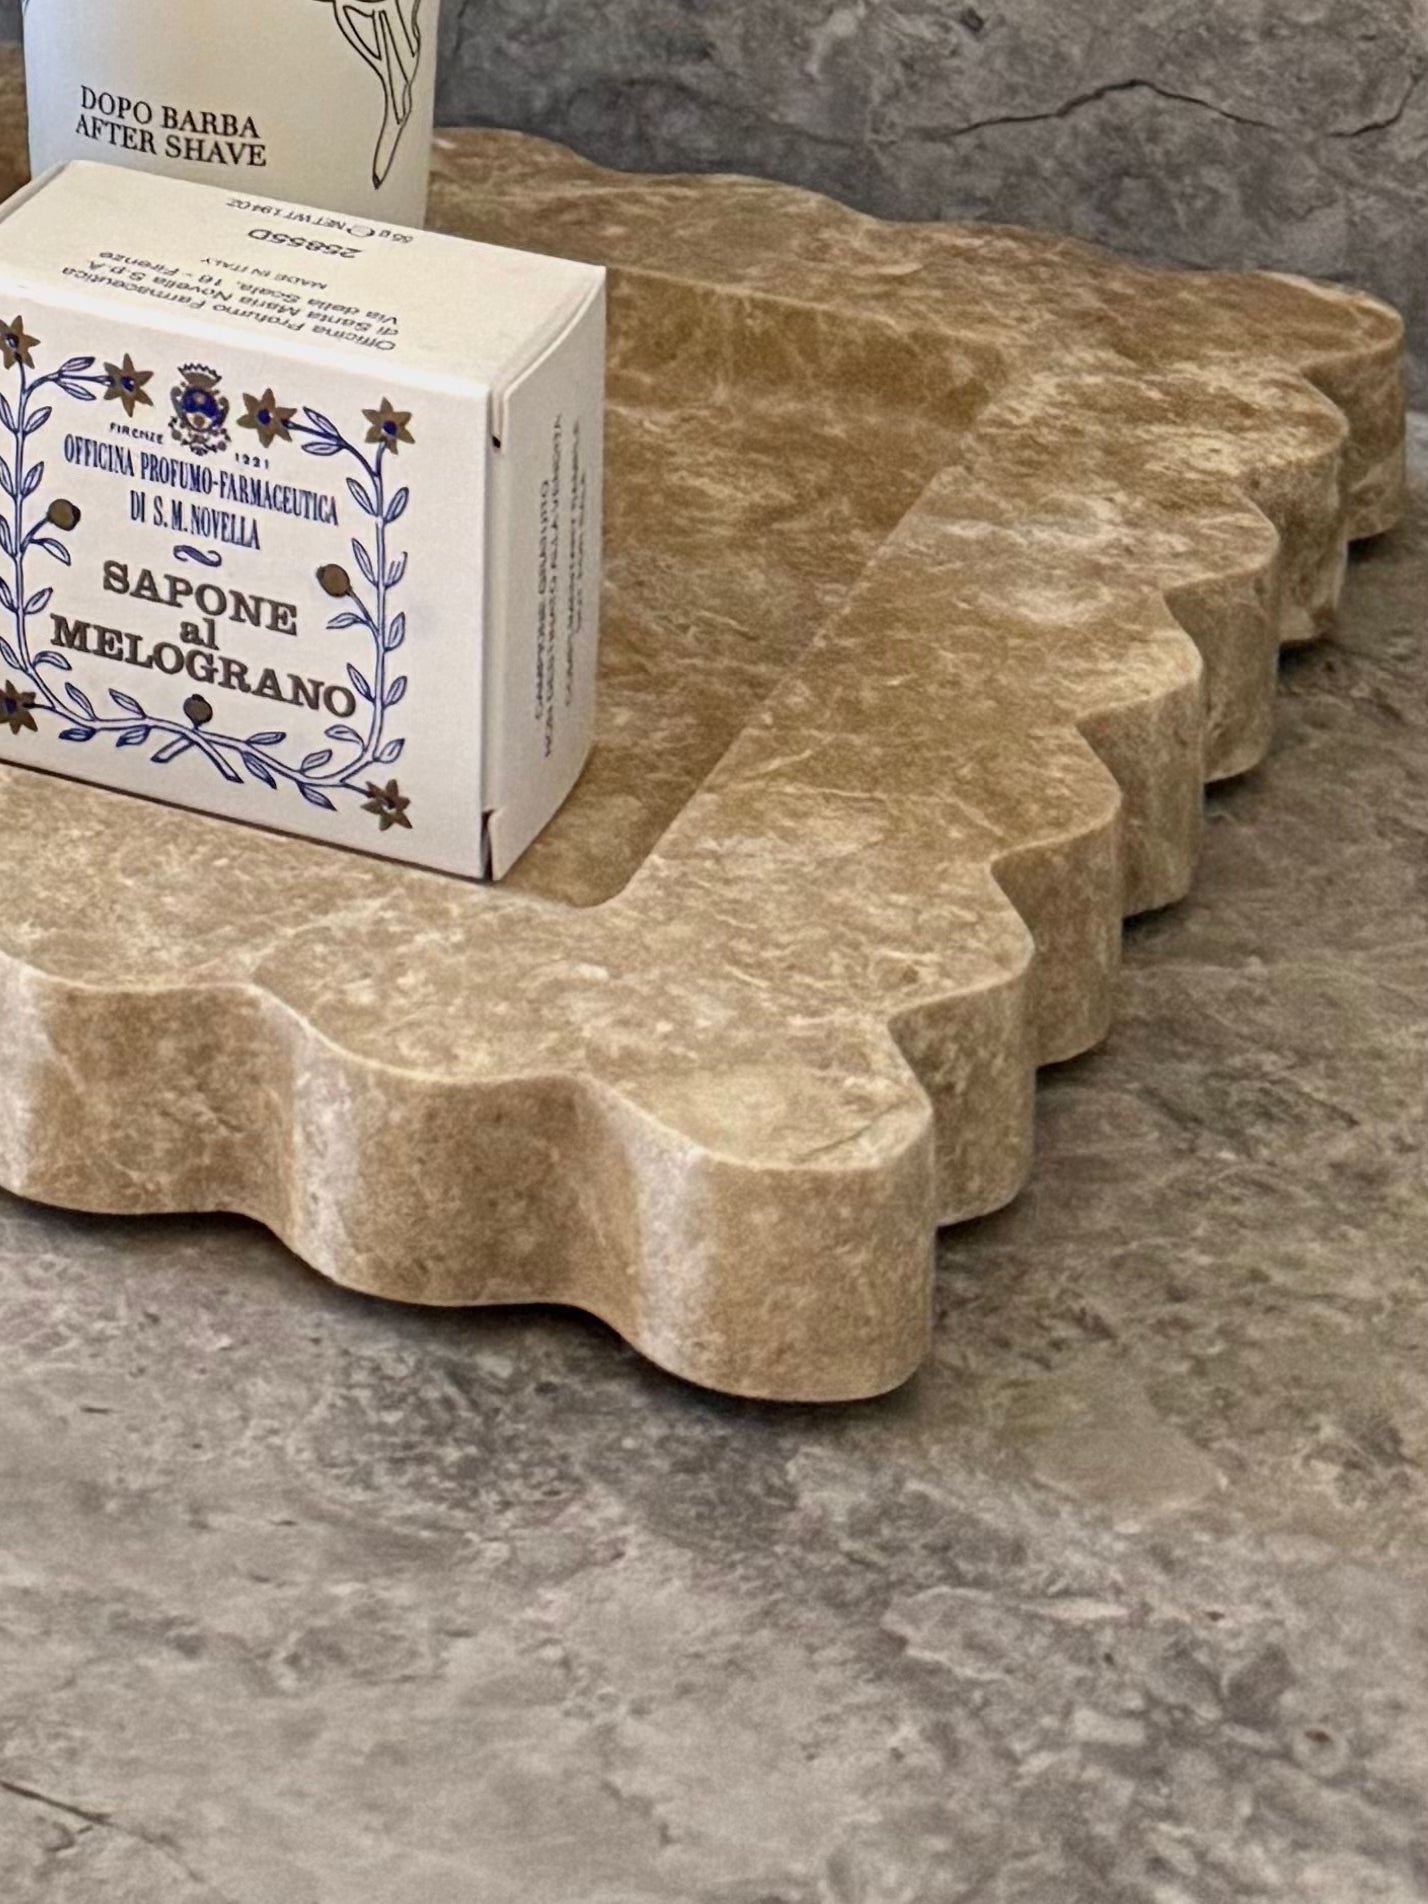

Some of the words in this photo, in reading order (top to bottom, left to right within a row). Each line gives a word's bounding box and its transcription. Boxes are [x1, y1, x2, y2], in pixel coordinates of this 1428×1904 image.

[81, 85, 153, 124] DOPO
[161, 106, 260, 139] BARBA
[75, 115, 155, 155] AFTER
[166, 136, 267, 167] SHAVE
[99, 252, 180, 276] Firenze
[200, 257, 247, 273] ITALY
[252, 268, 271, 277] IN
[61, 267, 206, 309] Farmaceutica
[153, 276, 233, 302] Novella
[275, 273, 328, 290] MADE
[212, 304, 305, 331] Profumo
[238, 297, 300, 317] Maria
[308, 298, 360, 316] della
[367, 311, 398, 326] Via
[306, 311, 373, 332] Santa
[377, 326, 399, 338] di
[311, 325, 396, 351] Officina
[110, 422, 164, 444] FIRENZE
[235, 452, 270, 470] 1221
[64, 433, 134, 477] OFFICINA
[140, 452, 338, 526] PROFUMO-FARMACEUTICA
[130, 490, 145, 523] DI
[190, 504, 260, 550] NOVELLA
[102, 561, 298, 637] SAPONE
[179, 618, 220, 650] al
[49, 614, 357, 718] MELOGRANO
